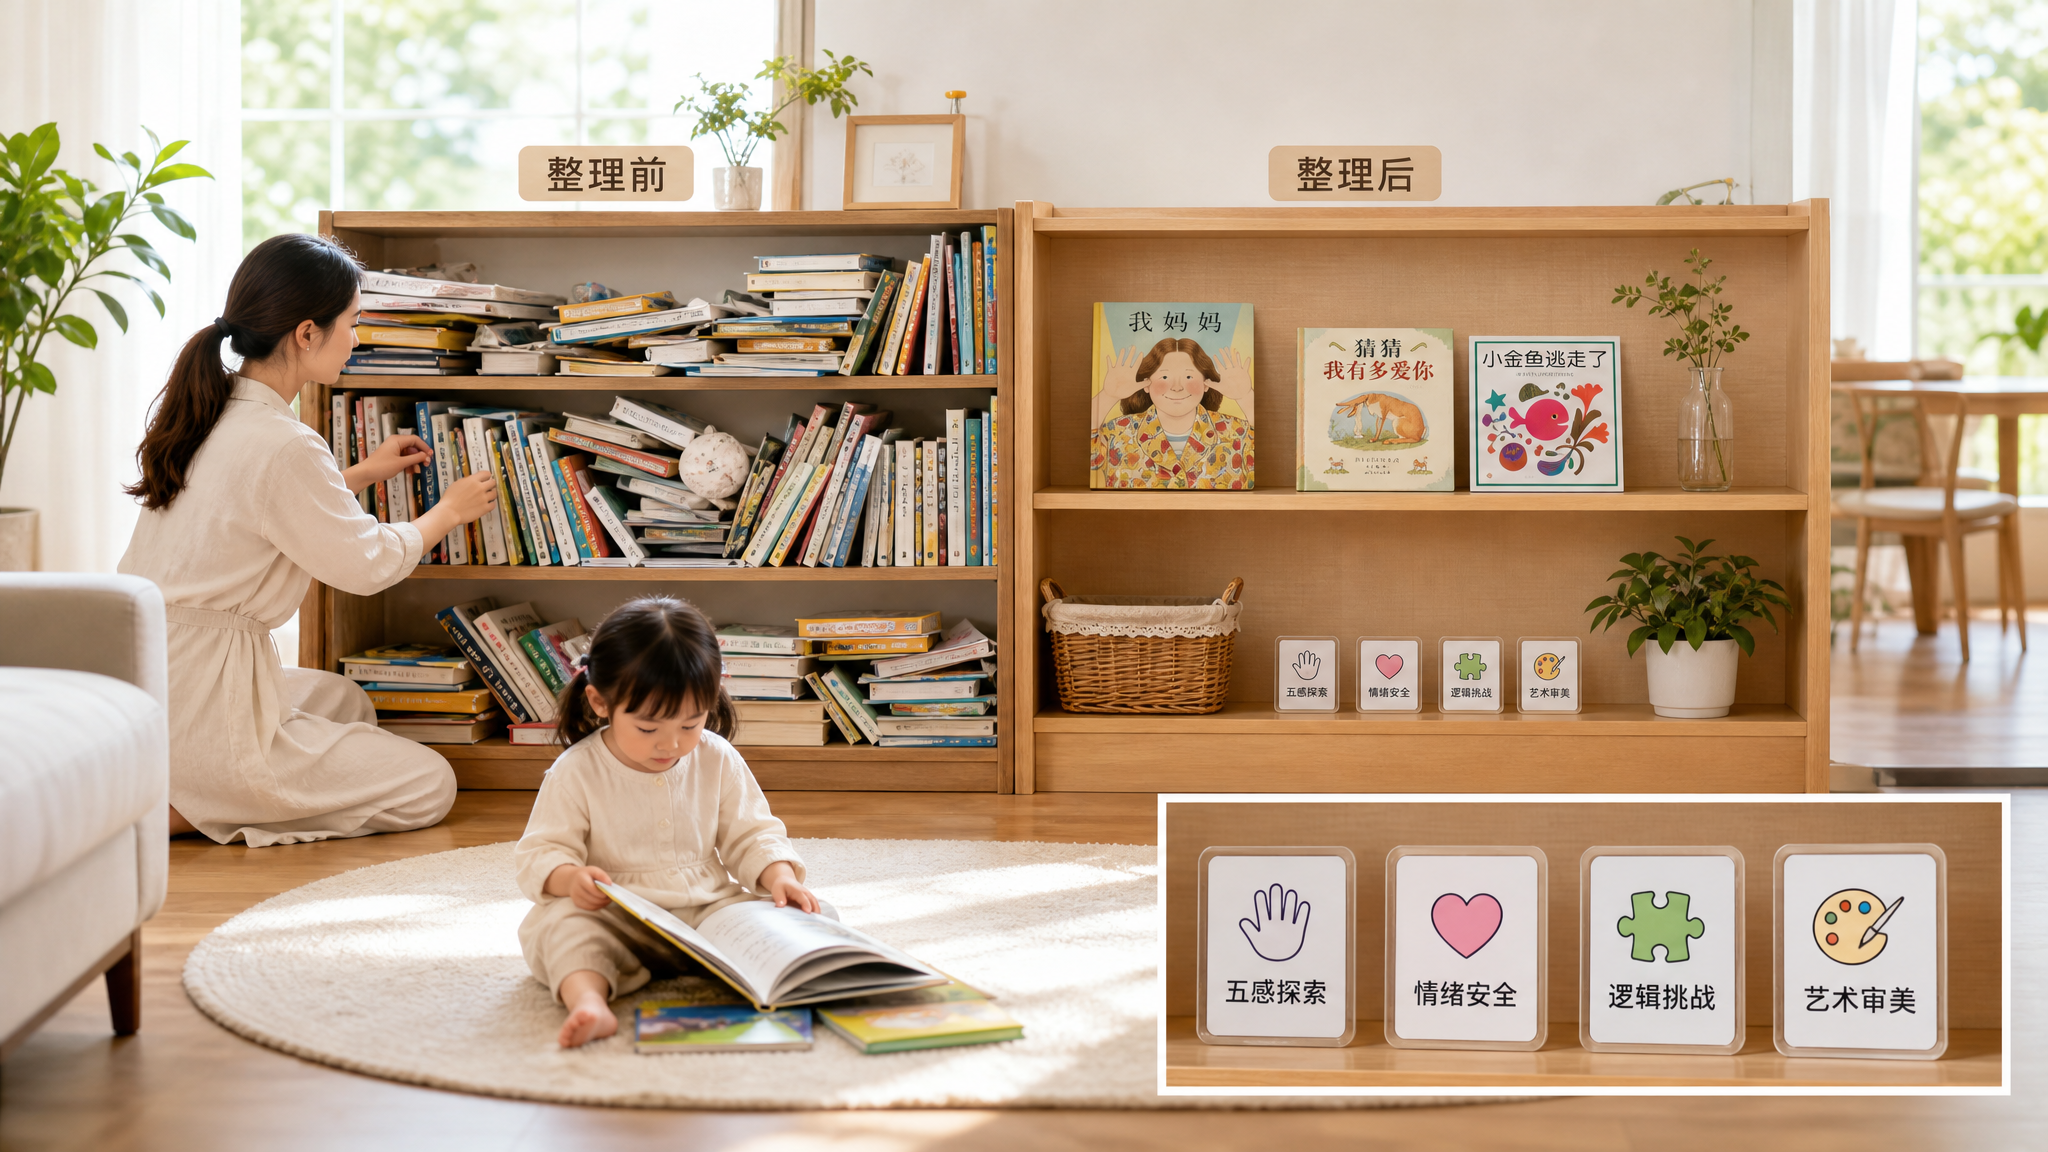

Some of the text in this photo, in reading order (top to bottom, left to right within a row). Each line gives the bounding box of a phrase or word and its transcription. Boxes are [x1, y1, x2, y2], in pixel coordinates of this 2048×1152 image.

[1128, 311, 1222, 333] 我妈妈
[1354, 338, 1402, 359] 猜猜
[1482, 349, 1607, 369] 小金鱼逃走了
[1323, 360, 1434, 381] 我有多爱你
[1225, 979, 1326, 1005] 五感探索
[1413, 981, 1517, 1008] 情绪安全
[1608, 984, 1716, 1011] 逻辑挑战
[1804, 986, 1916, 1015] 艺术审美
